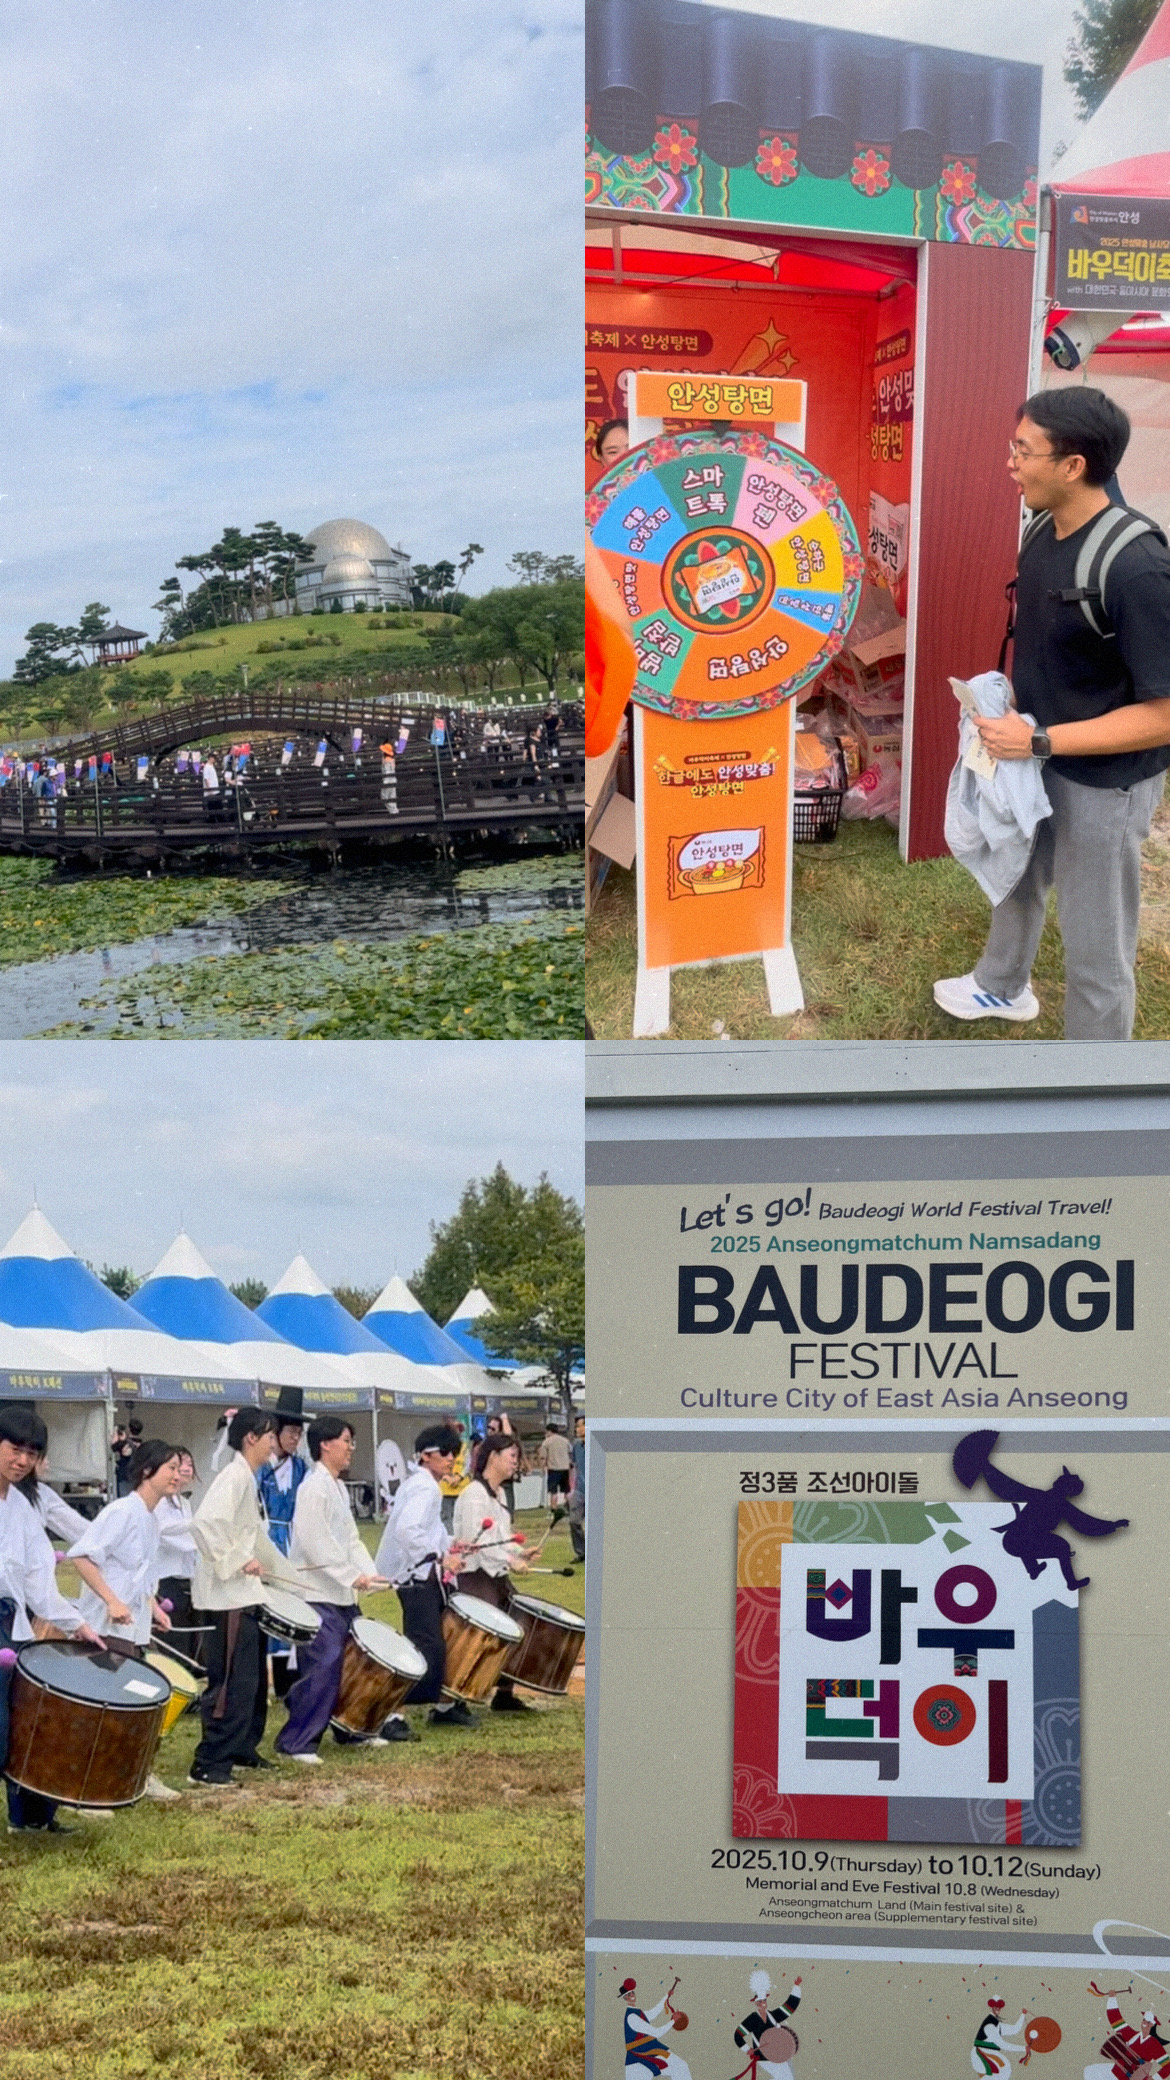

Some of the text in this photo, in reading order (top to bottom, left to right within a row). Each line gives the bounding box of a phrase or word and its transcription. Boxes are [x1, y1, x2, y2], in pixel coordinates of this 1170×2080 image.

[1119, 211, 1140, 225] 안성
[641, 333, 699, 352] 안성탕면
[667, 381, 774, 416] 안성탕면
[682, 464, 726, 491] 스마
[746, 473, 808, 523] 안성탕면
[628, 505, 672, 553] 안성탕면
[701, 573, 741, 597] 안성탕면
[708, 634, 790, 681] 안성탕면
[658, 761, 776, 786] 한글에도 안성맞춤!
[690, 780, 745, 799] 안성탕면
[691, 842, 745, 861] 안성탕면
[680, 1187, 1113, 1233] Let's go! Baudeogi World Festival Travel!
[710, 1230, 1101, 1255] 2025 Anseongmatchum Namsadang
[676, 1259, 1135, 1335] BAUDEOGI
[789, 1342, 1018, 1379] FESTIVAL
[680, 1387, 1128, 1411] Culture City of East Asia Anseong
[739, 1471, 919, 1494] 정3품 조선아이돌
[928, 1855, 954, 1876] to
[745, 1876, 1060, 1899] Memorial and Eve Festival 10.8 (Wednesday)
[758, 1907, 1038, 1927] Anseongcheon area (Supplementary festival site)
[768, 1896, 1025, 1914] Anseongmatchum Land (Main festival site) &
